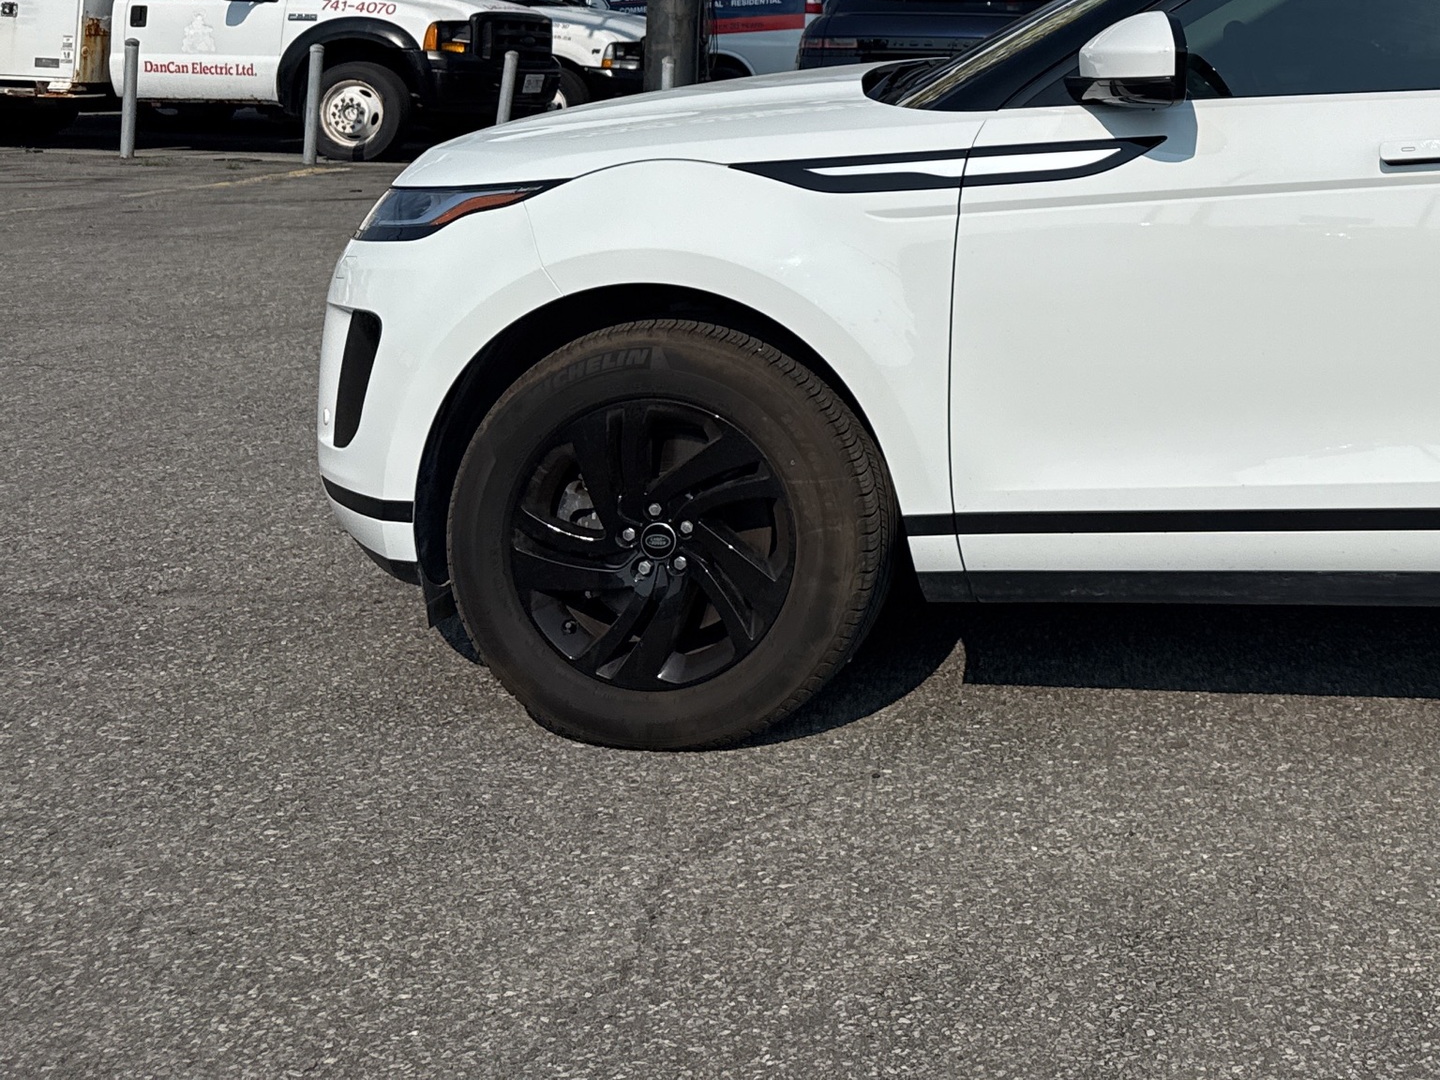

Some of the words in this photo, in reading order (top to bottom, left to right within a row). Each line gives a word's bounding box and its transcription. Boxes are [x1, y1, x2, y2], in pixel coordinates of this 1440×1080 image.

[144, 61, 189, 74] DanCan
[191, 62, 234, 76] Electric
[235, 63, 258, 77] Ltd.
